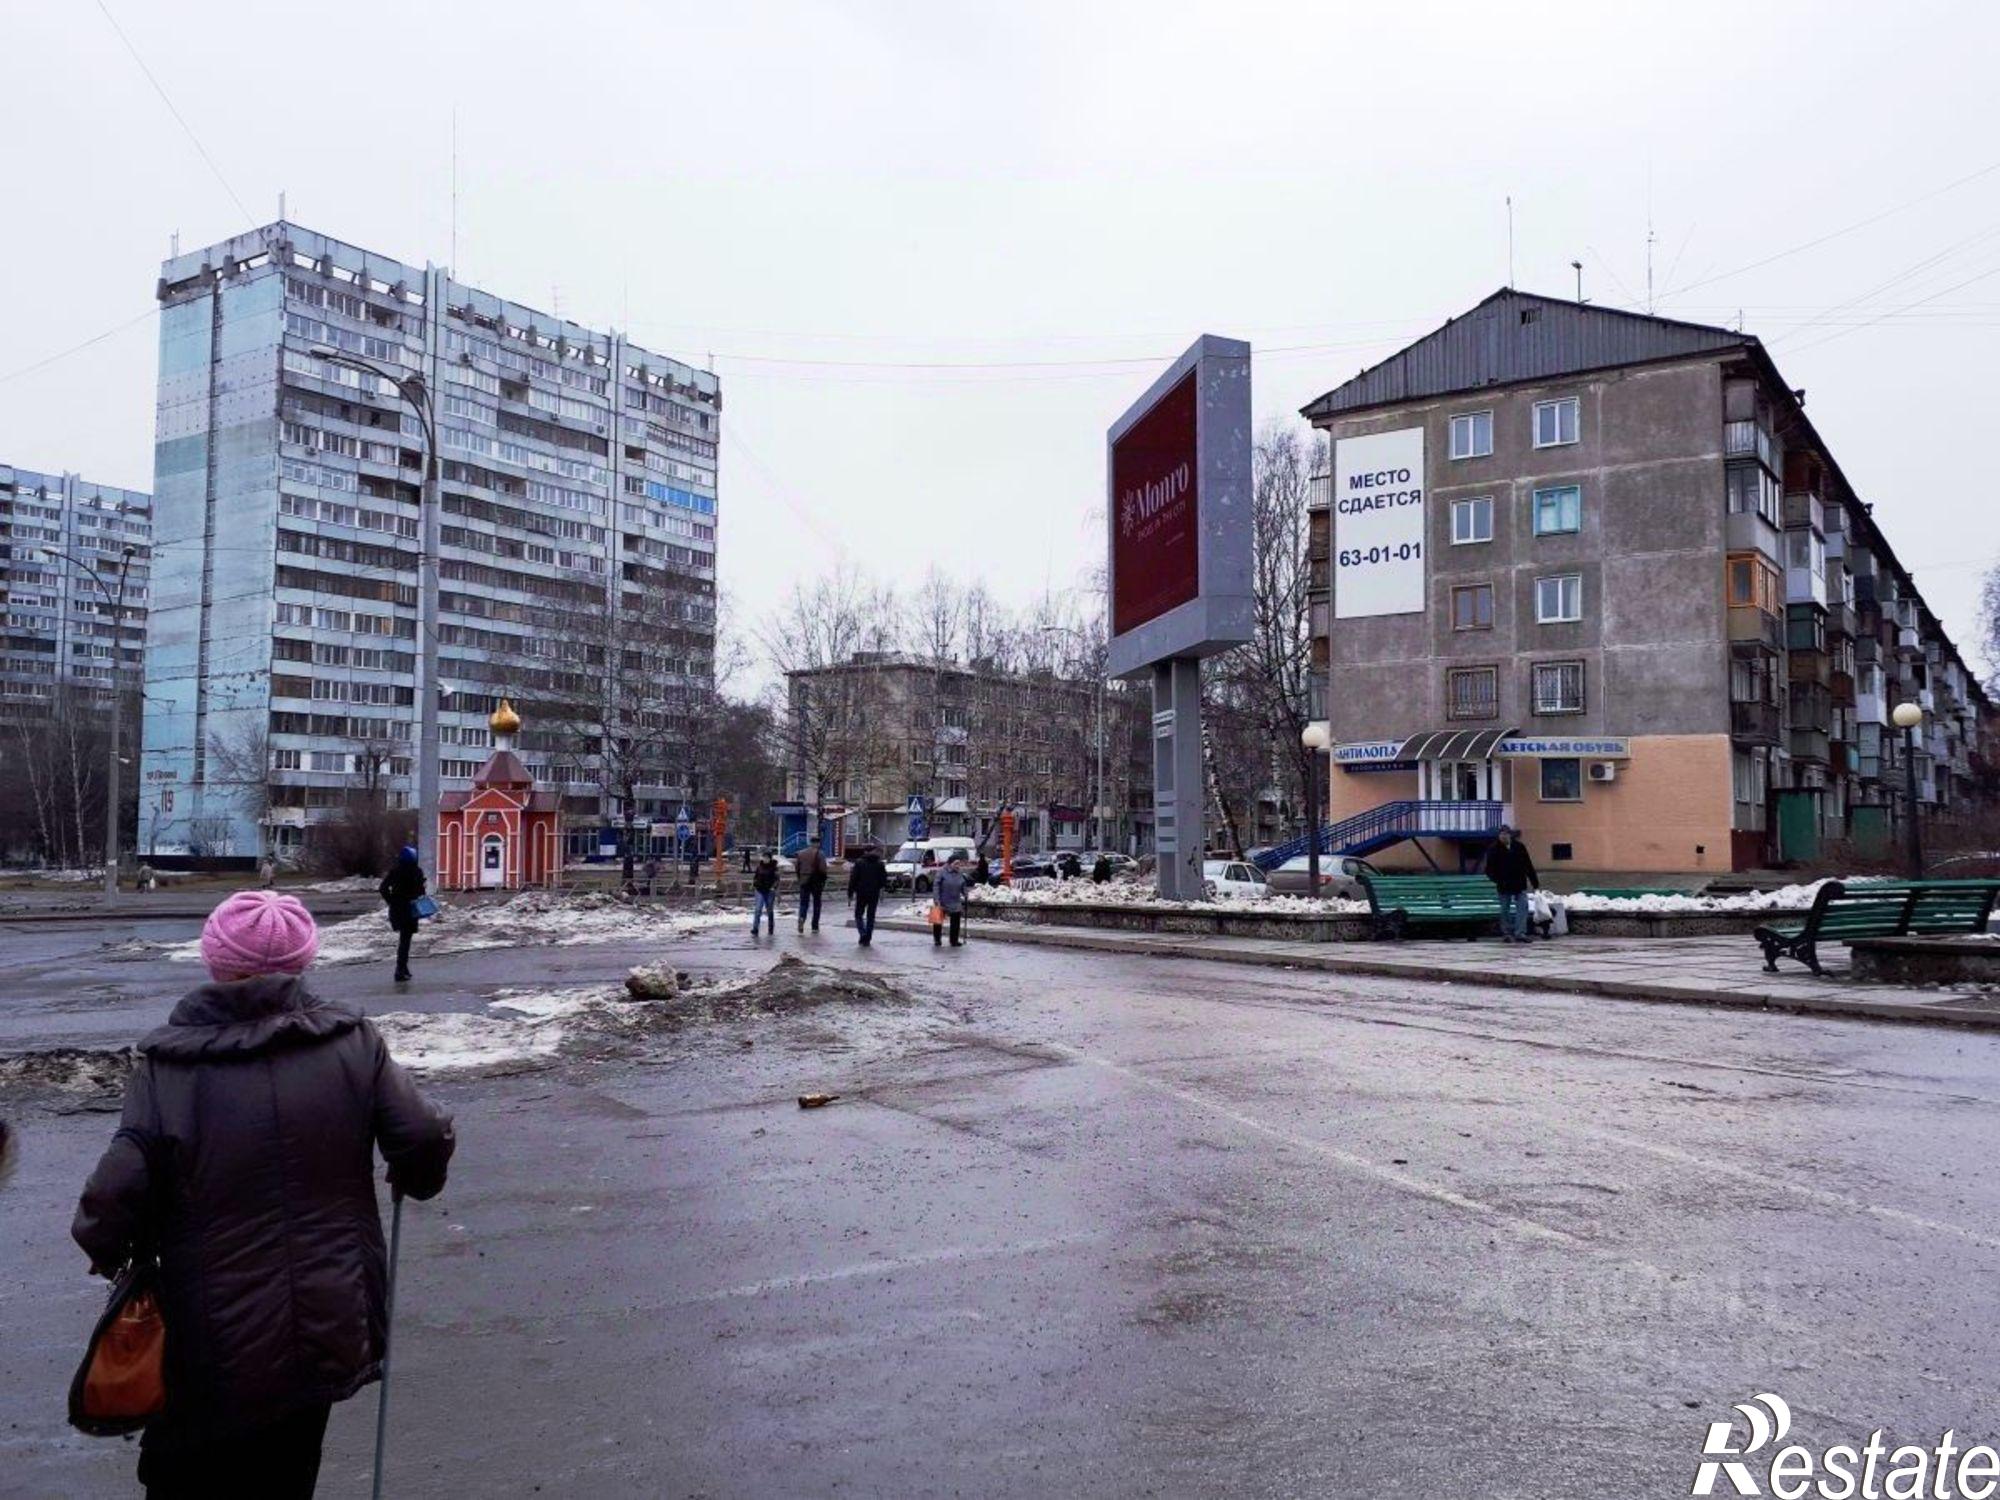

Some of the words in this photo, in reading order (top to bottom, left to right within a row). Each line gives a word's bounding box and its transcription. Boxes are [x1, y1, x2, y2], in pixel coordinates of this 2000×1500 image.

[1137, 463, 1189, 520] Monro
[1349, 468, 1411, 490] МЕСТО
[1338, 489, 1421, 515] СДАЕТСЯ
[1339, 542, 1421, 567] 63-01-01
[1499, 742, 1570, 752] ДЕТСКАЯ
[1572, 742, 1624, 752] ОБУВЬ
